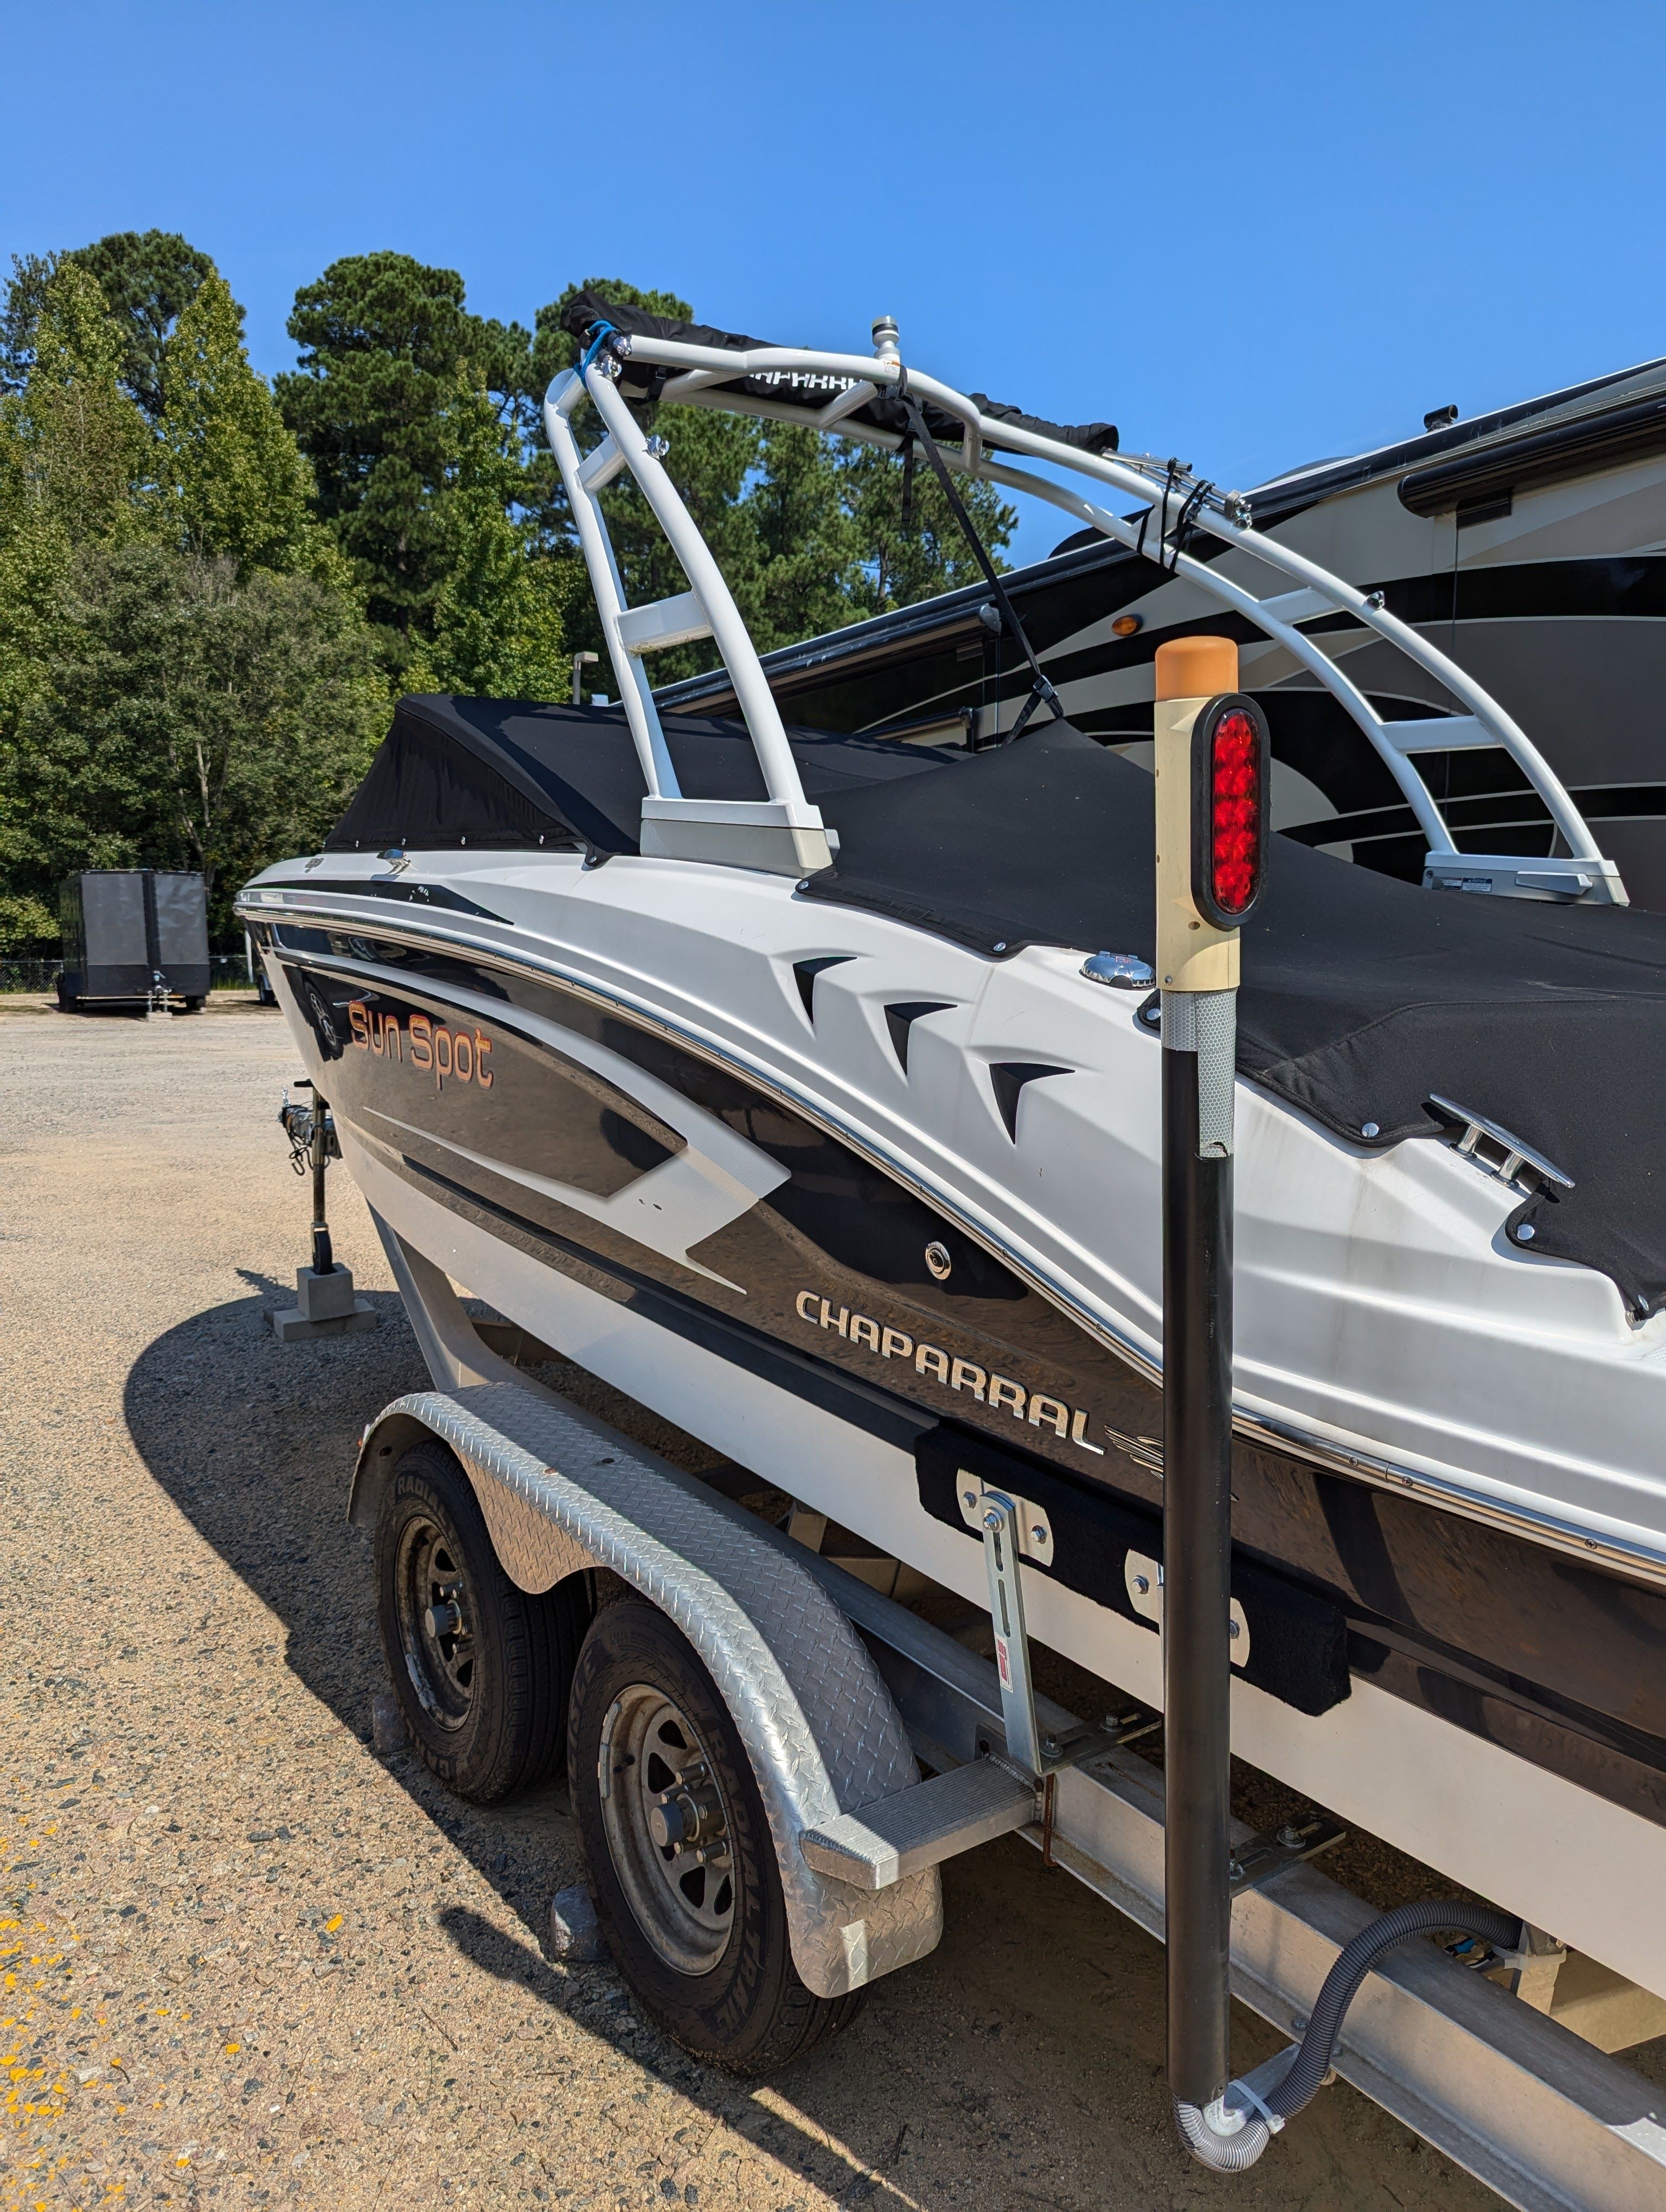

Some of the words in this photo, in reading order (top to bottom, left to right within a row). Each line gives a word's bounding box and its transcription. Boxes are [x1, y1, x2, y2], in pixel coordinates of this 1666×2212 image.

[349, 1001, 401, 1062] Sun
[409, 1014, 494, 1090] Spot
[796, 1290, 1105, 1456] CHAPARRAL
